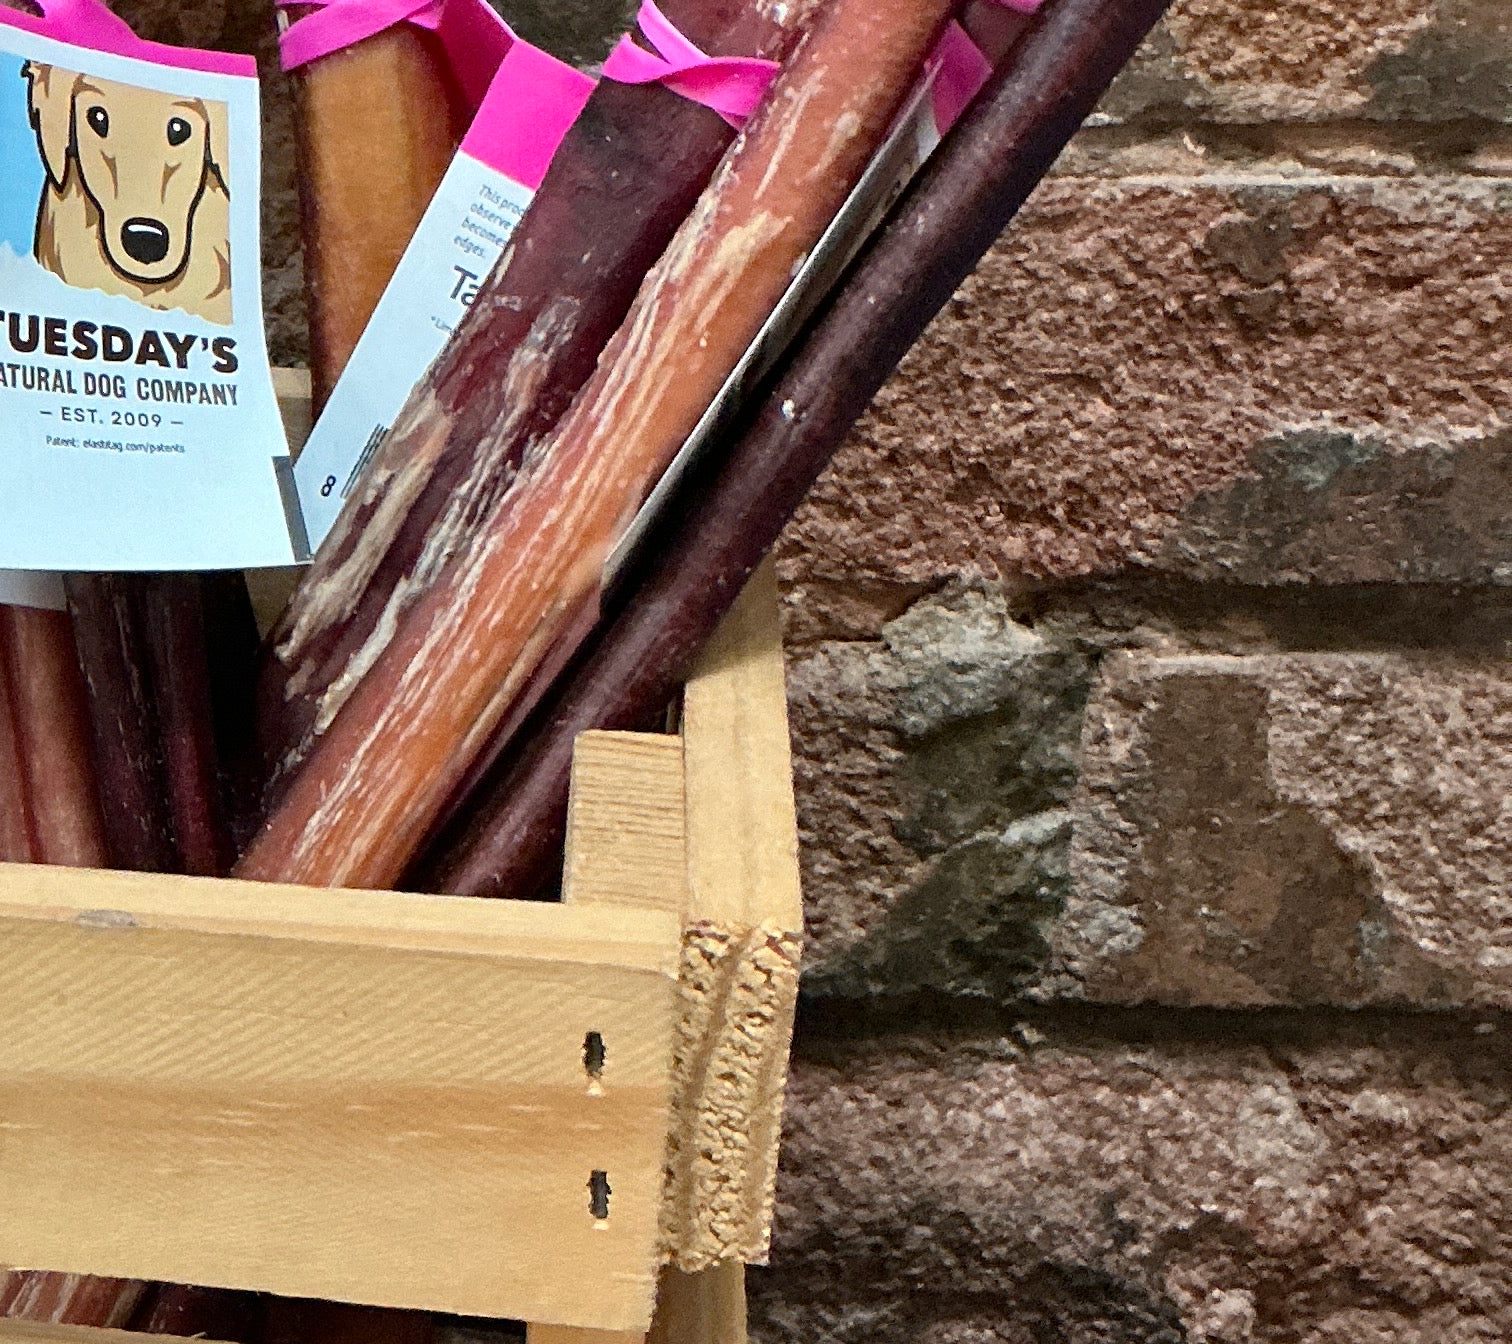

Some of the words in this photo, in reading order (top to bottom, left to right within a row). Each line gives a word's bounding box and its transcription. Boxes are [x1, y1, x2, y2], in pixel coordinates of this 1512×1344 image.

[479, 184, 501, 205] This
[470, 203, 512, 230] observe
[84, 371, 127, 398] DOG
[136, 377, 238, 406] COMPANY
[61, 407, 104, 424] EST.
[111, 411, 162, 427] 2009
[320, 475, 337, 497] 8
